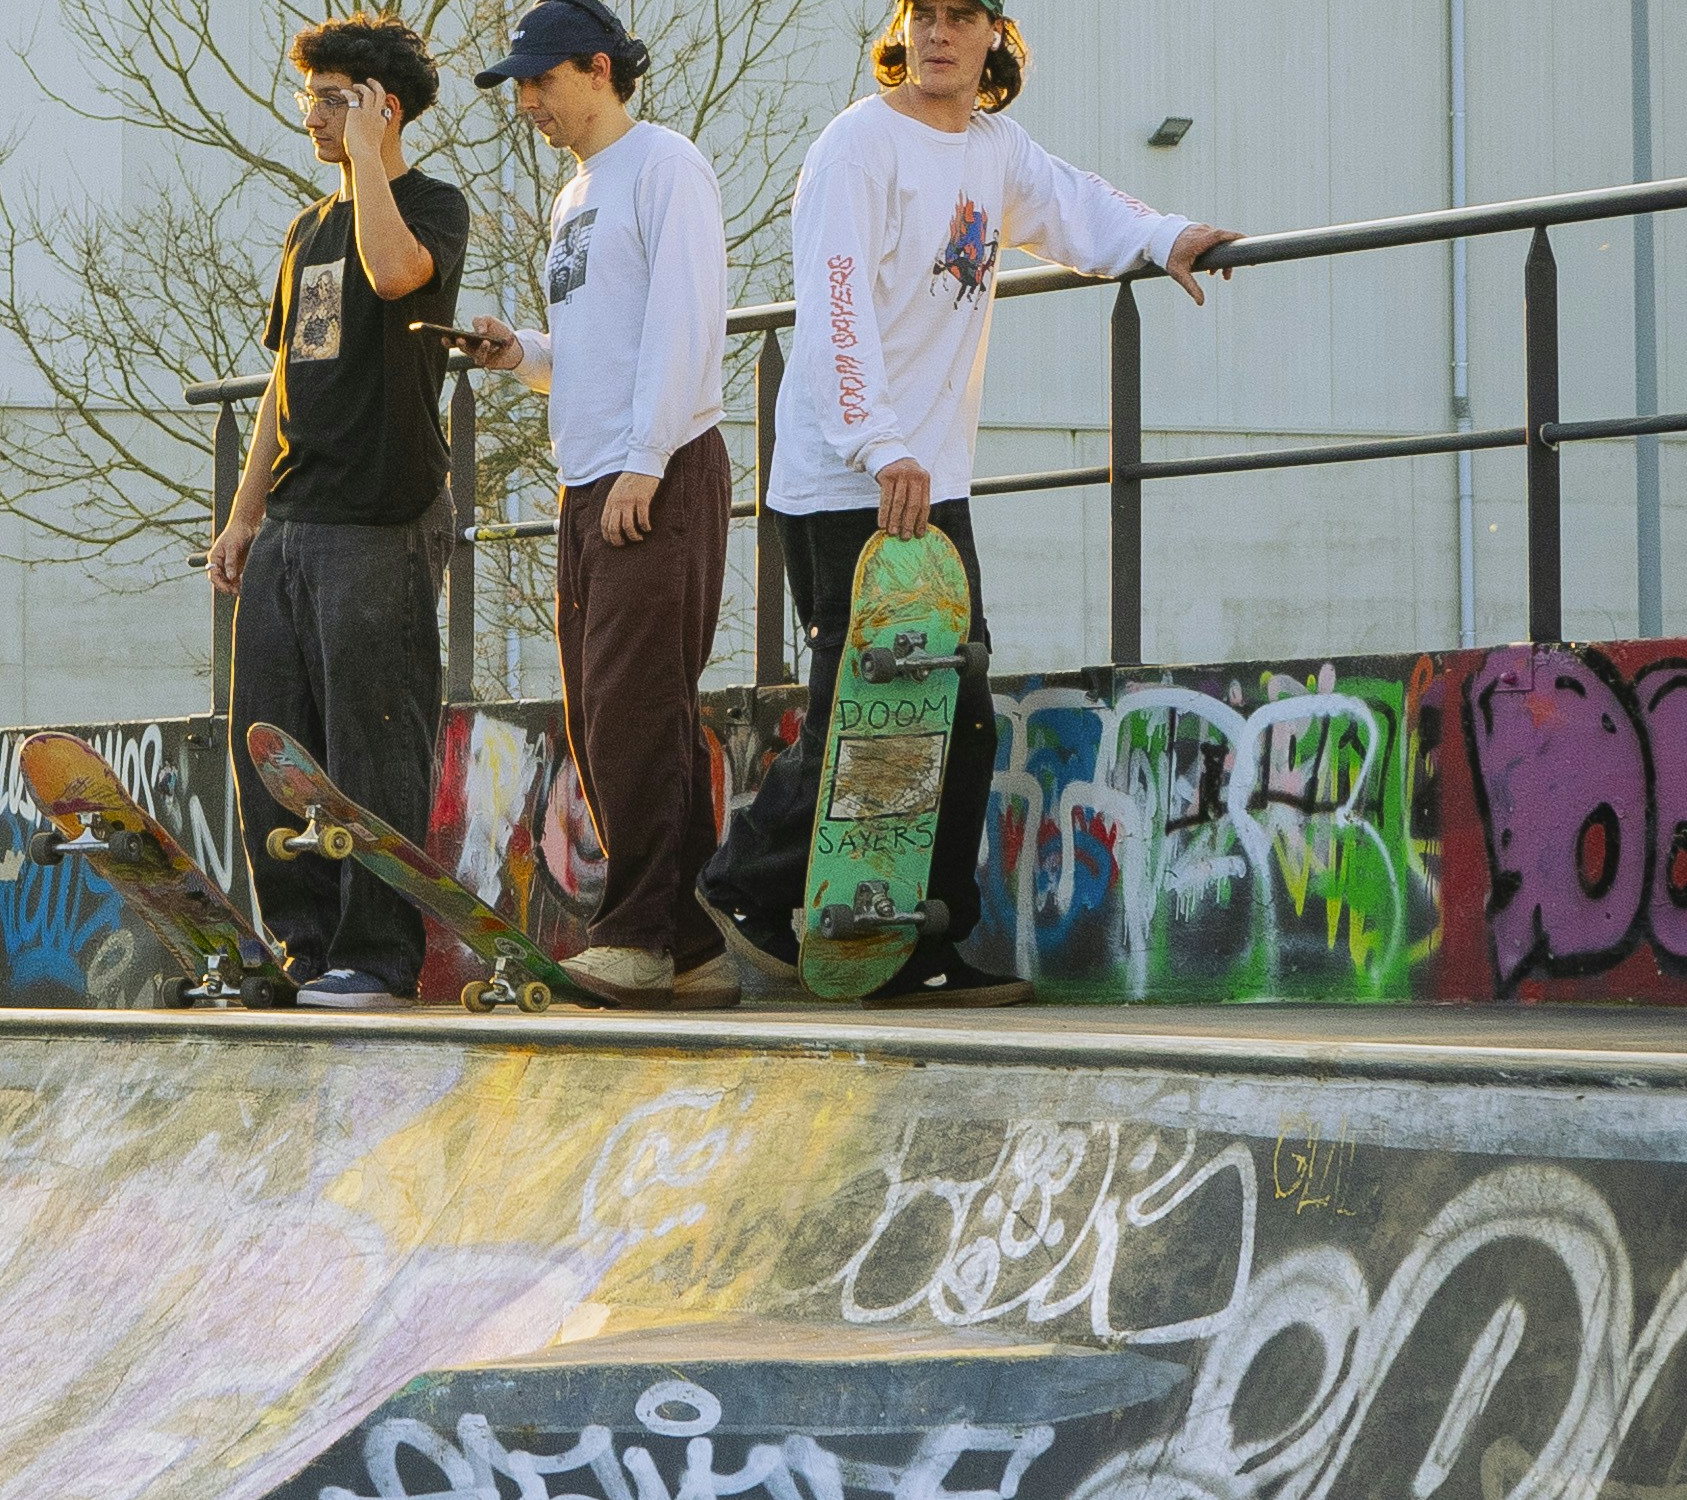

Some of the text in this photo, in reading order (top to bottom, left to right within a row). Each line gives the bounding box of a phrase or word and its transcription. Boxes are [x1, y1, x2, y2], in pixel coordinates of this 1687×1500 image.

[826, 254, 870, 425] DOOM SAYERS
[837, 694, 951, 731] DOOM
